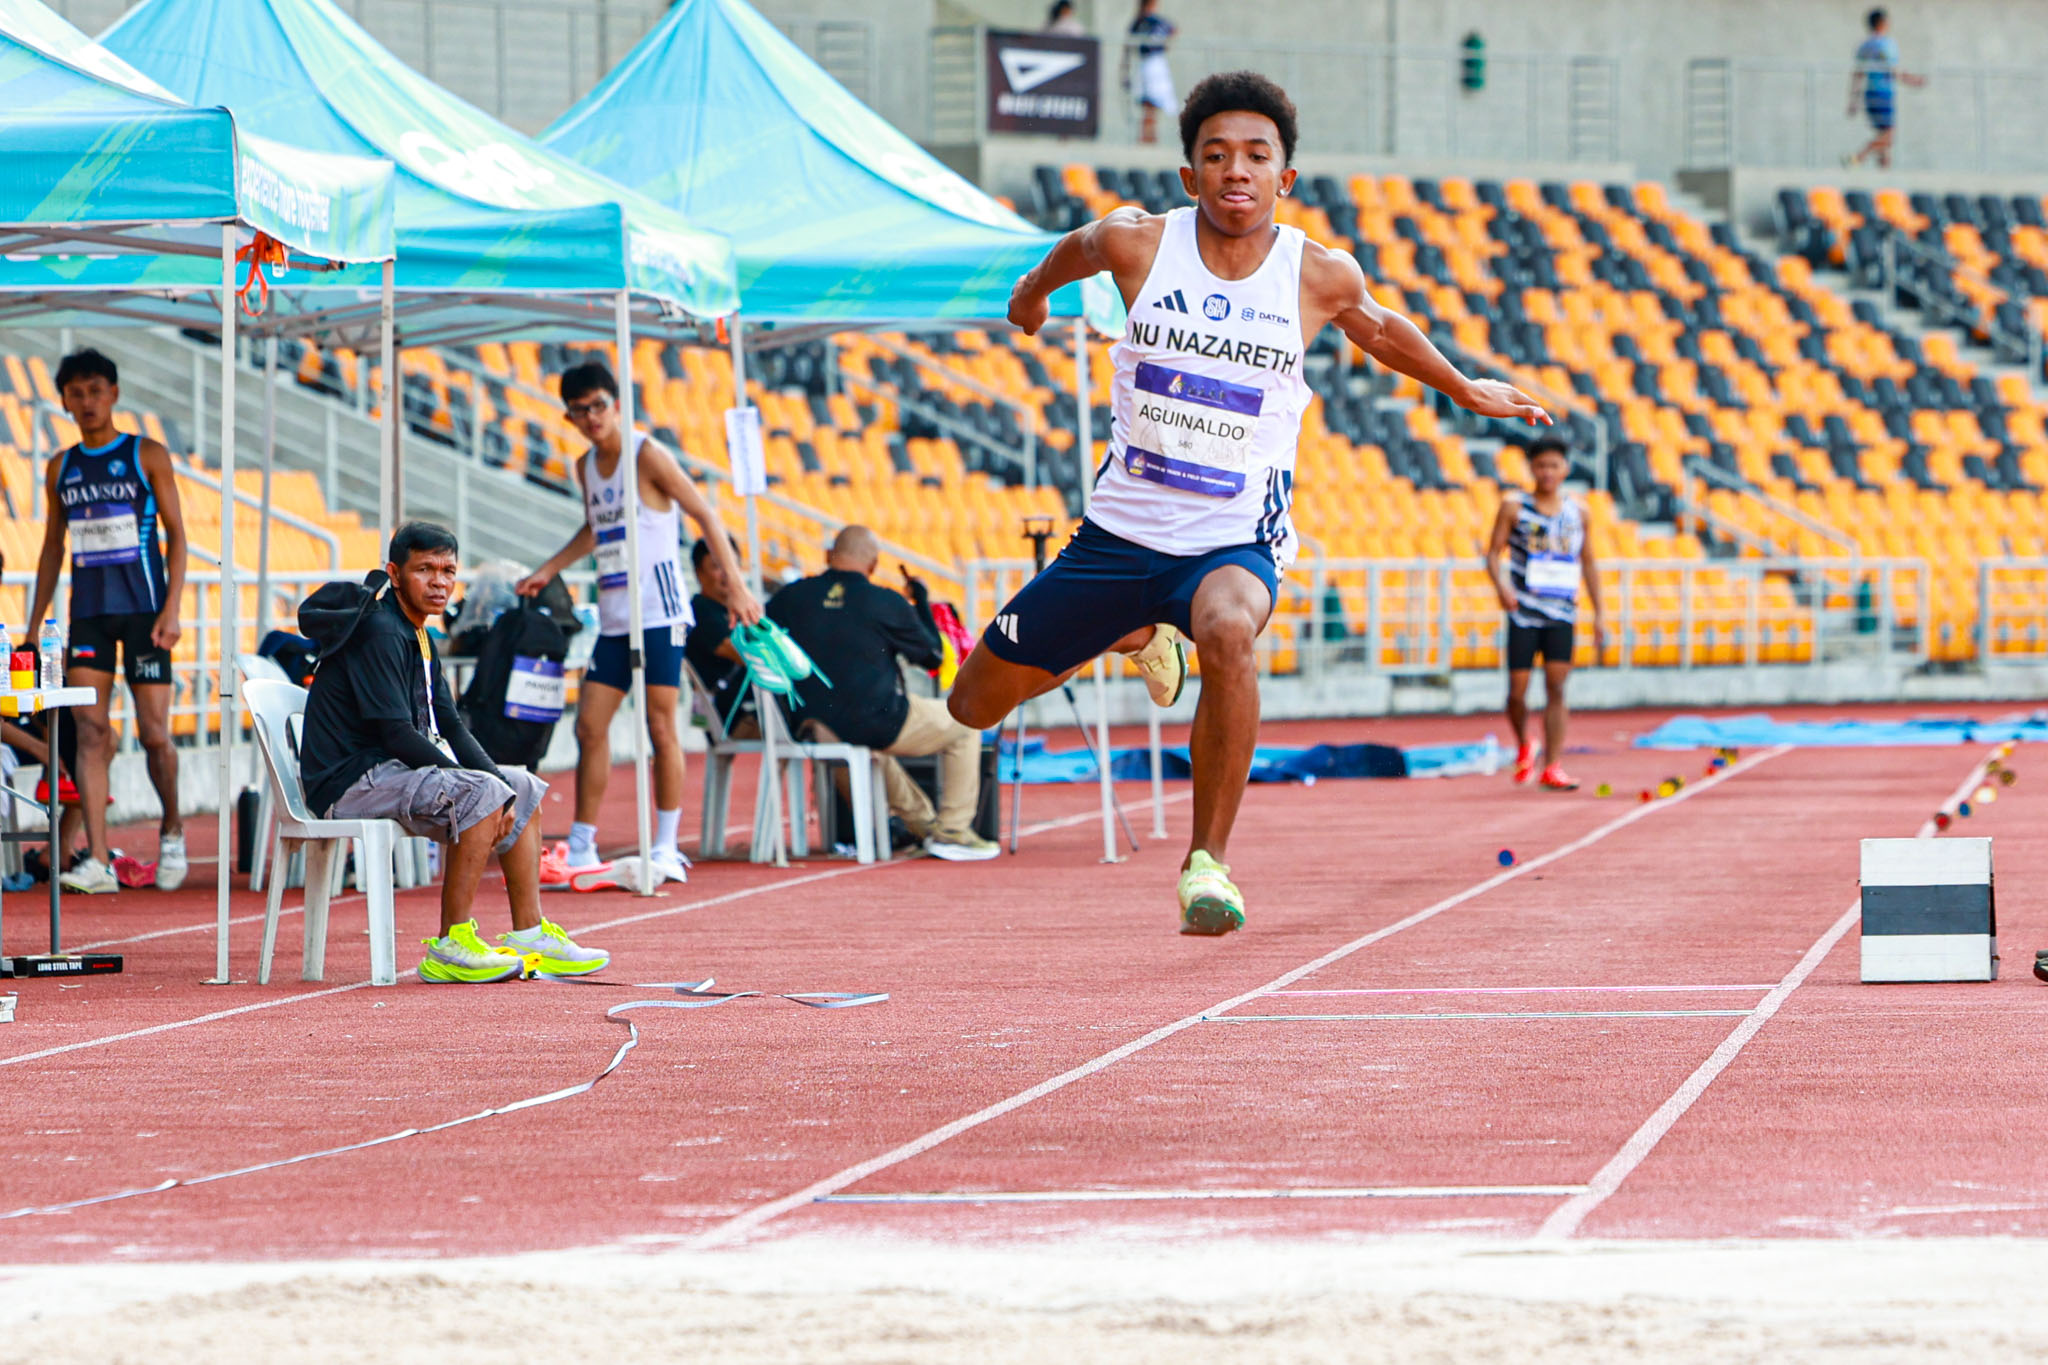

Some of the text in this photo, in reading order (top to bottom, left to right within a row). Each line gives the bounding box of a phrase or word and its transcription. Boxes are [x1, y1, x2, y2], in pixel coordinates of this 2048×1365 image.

[1259, 312, 1289, 325] DATEM
[1131, 321, 1297, 375] NU NAZARETH
[1138, 404, 1245, 441] AGUINALDO
[37, 962, 52, 971] LONG
[53, 961, 68, 971] STEEL
[69, 961, 83, 970] TAPE
